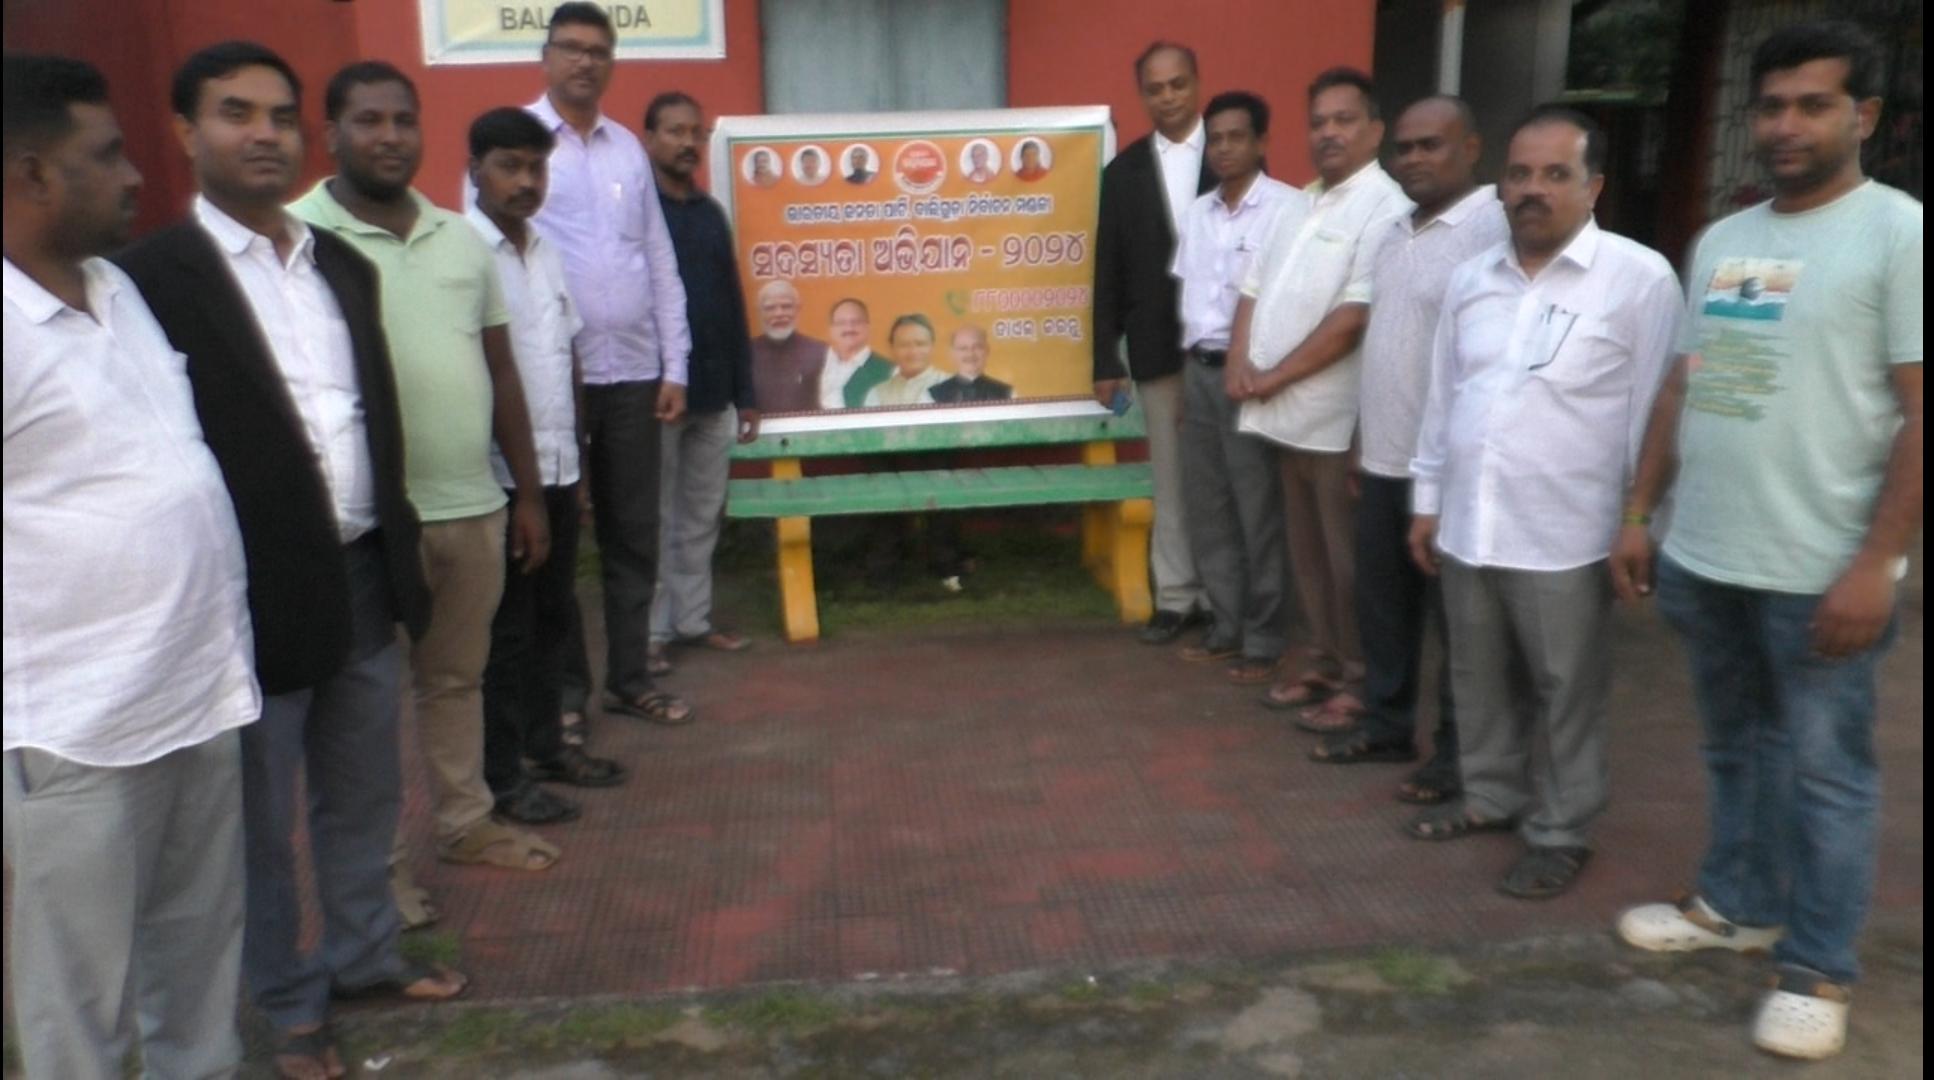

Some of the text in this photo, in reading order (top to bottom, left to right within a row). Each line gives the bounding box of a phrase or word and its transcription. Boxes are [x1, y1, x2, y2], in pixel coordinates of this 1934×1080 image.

[844, 203, 880, 219] ଜନତା
[752, 240, 864, 277] ସଦସ୍ୟତା
[873, 227, 971, 273] ଅଭିଯାନ
[1002, 232, 1086, 266] ୨୦୨୪
